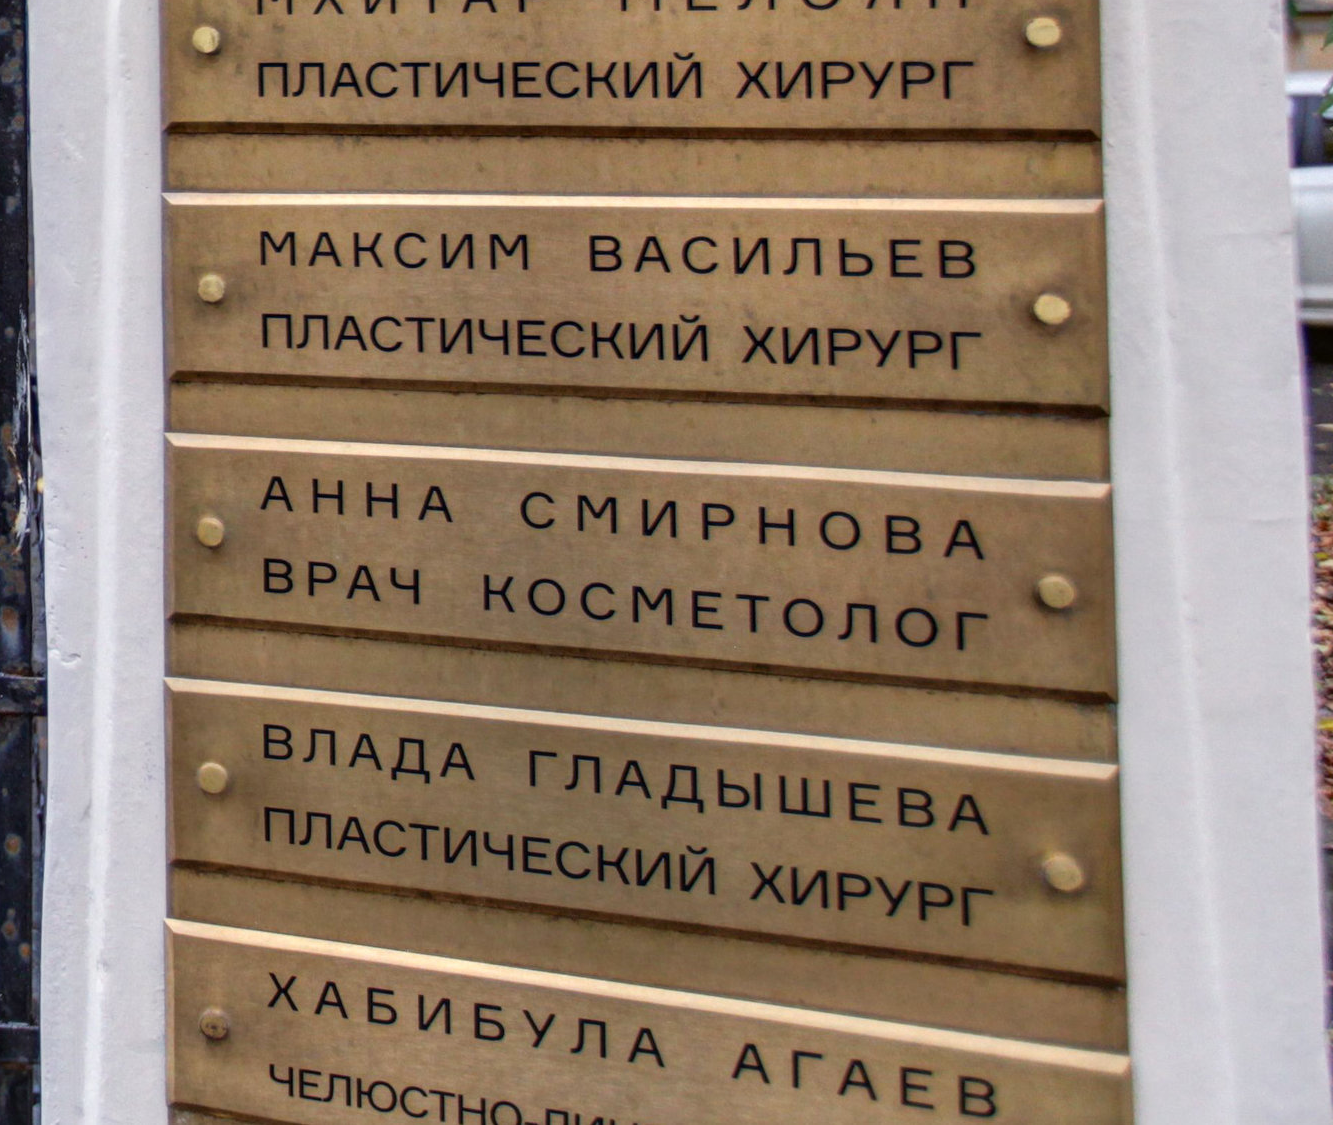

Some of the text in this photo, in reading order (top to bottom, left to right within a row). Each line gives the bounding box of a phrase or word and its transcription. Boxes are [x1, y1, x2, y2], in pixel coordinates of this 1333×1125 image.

[256, 51, 975, 102] ПЛАСТИЧЕСКИЙ ХИРУРГ
[259, 230, 978, 280] МАКСИМ ВАСИЛЬЕВ
[260, 312, 983, 372] ПЛАСТИЧЕСКИЙ ХИРУРГ
[259, 474, 987, 562] АННА СМИРНОВА
[262, 556, 990, 652] ВРАЧ КОСМЕТОЛОГ
[262, 722, 992, 837] ВЛАДА ГЛАДЫШЕВА
[262, 805, 996, 928] ПЛАСТИЧЕСКИЙ ХИРУРГ
[266, 971, 999, 1119] ХАБИБУЛА АГАЕВ
